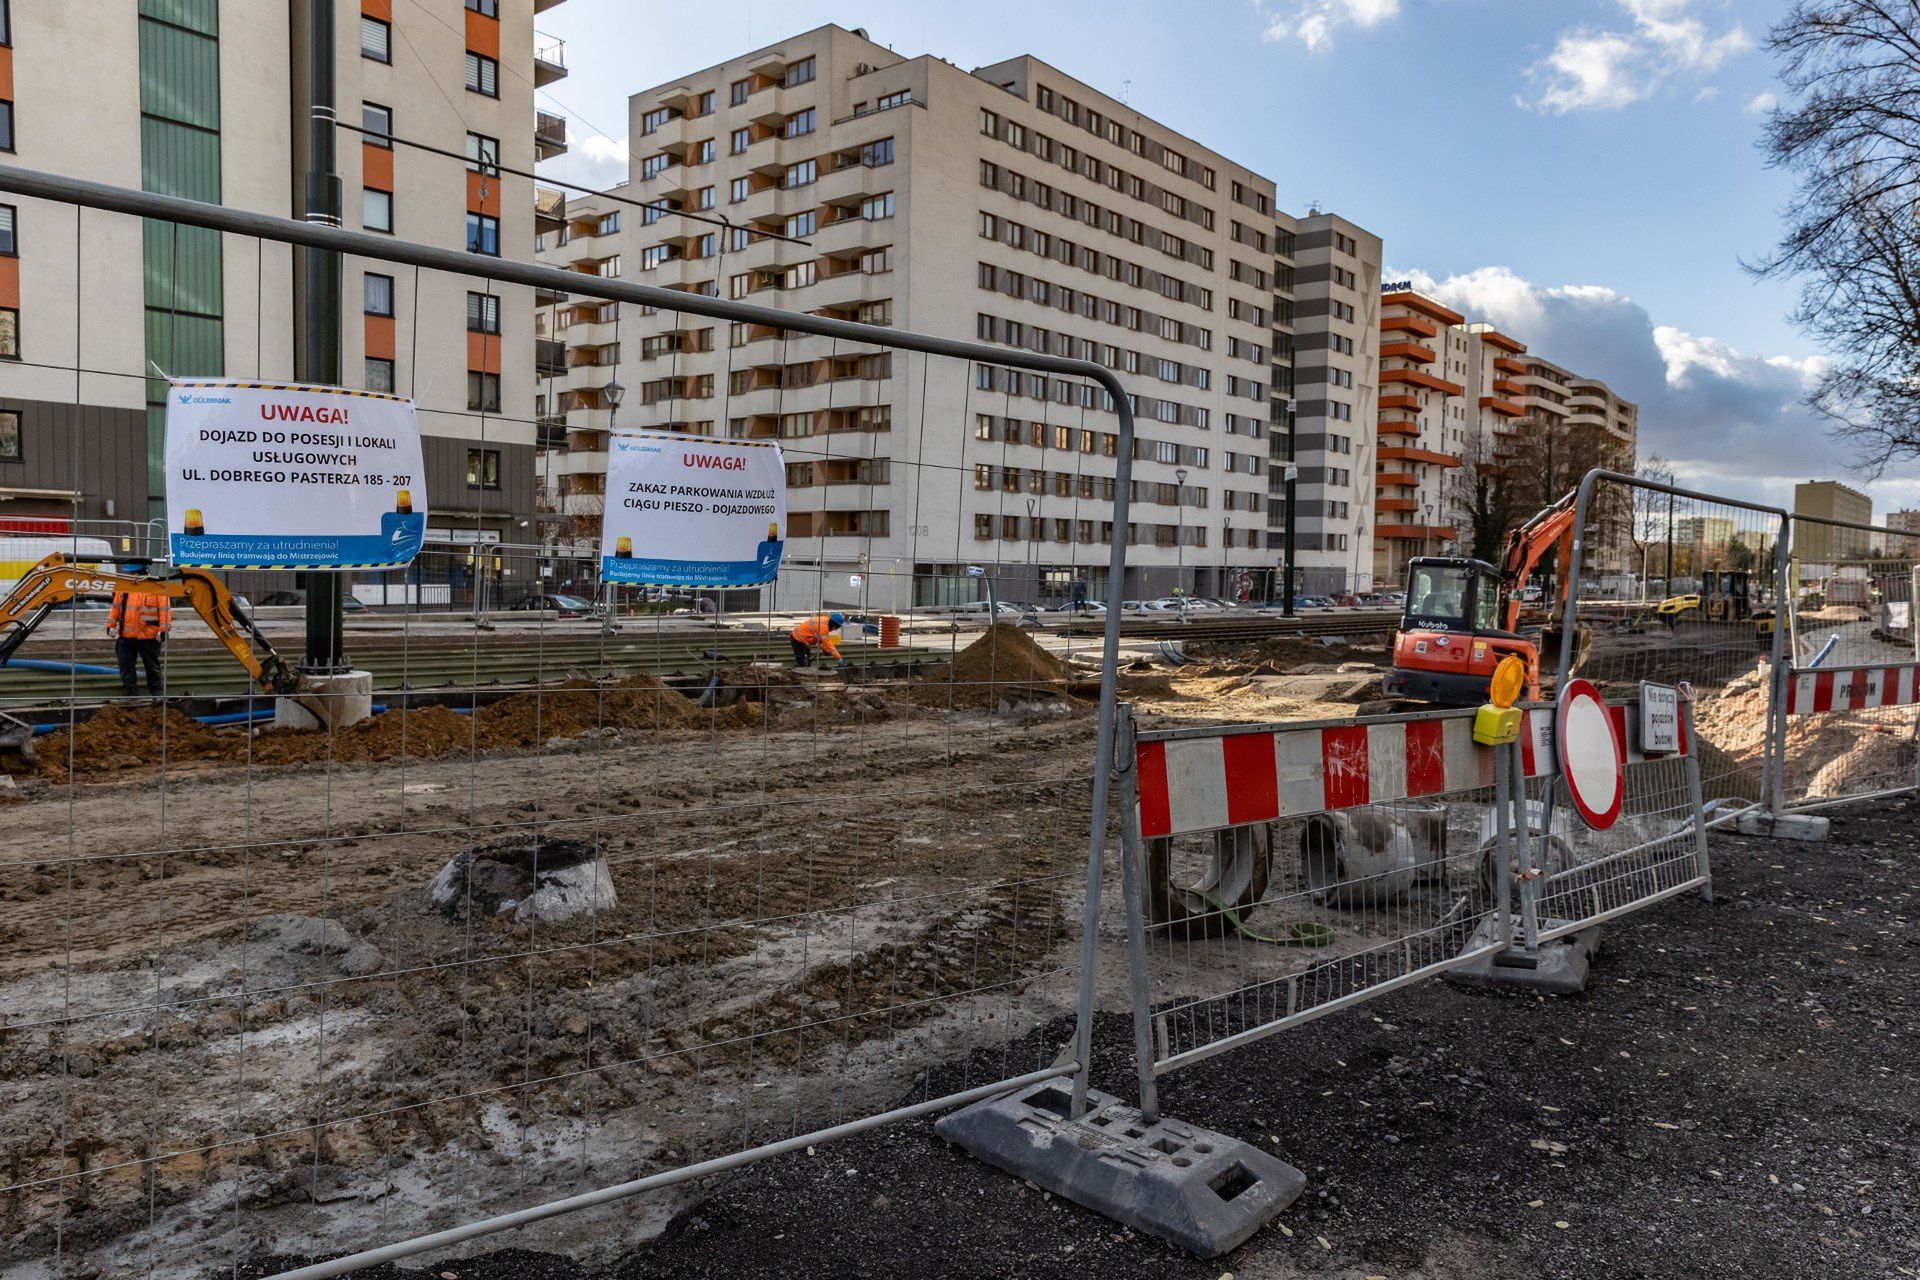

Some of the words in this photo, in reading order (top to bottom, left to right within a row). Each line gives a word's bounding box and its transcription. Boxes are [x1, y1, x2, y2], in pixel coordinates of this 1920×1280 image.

[261, 404, 348, 424] UWAGA!
[200, 430, 257, 444] DOJAZD
[262, 432, 286, 443] DO
[291, 433, 344, 449] POSESJI
[348, 436, 352, 446] I
[355, 437, 396, 449] LOKALI
[253, 451, 357, 465] USŁUGOWYCH
[683, 453, 746, 471] UWAGA!
[182, 469, 205, 481] UL.
[210, 470, 286, 483] DOBREGO
[291, 472, 360, 485] PASTERZA
[363, 474, 383, 486] 185
[393, 475, 411, 487] 207
[629, 482, 667, 494] ZAKAZ
[670, 485, 743, 499] PARKOWANIA
[745, 488, 775, 499] WZDŁUŻ
[624, 498, 660, 511] CIĄGU
[664, 501, 703, 513] PIESZO
[712, 504, 776, 516] DOJAZDOWEGO
[179, 538, 253, 551] Przepraszamy
[257, 540, 270, 550] za
[272, 539, 339, 550] utrudnienia!
[180, 551, 216, 560] Budujemy
[218, 551, 235, 560] linię
[277, 552, 288, 560] do
[289, 552, 339, 560] Mistrzejowic
[610, 560, 670, 572] Przepraszamy
[683, 565, 730, 573] utrudnienia!
[64, 579, 116, 590] CASE
[1418, 620, 1449, 630] Kubota
